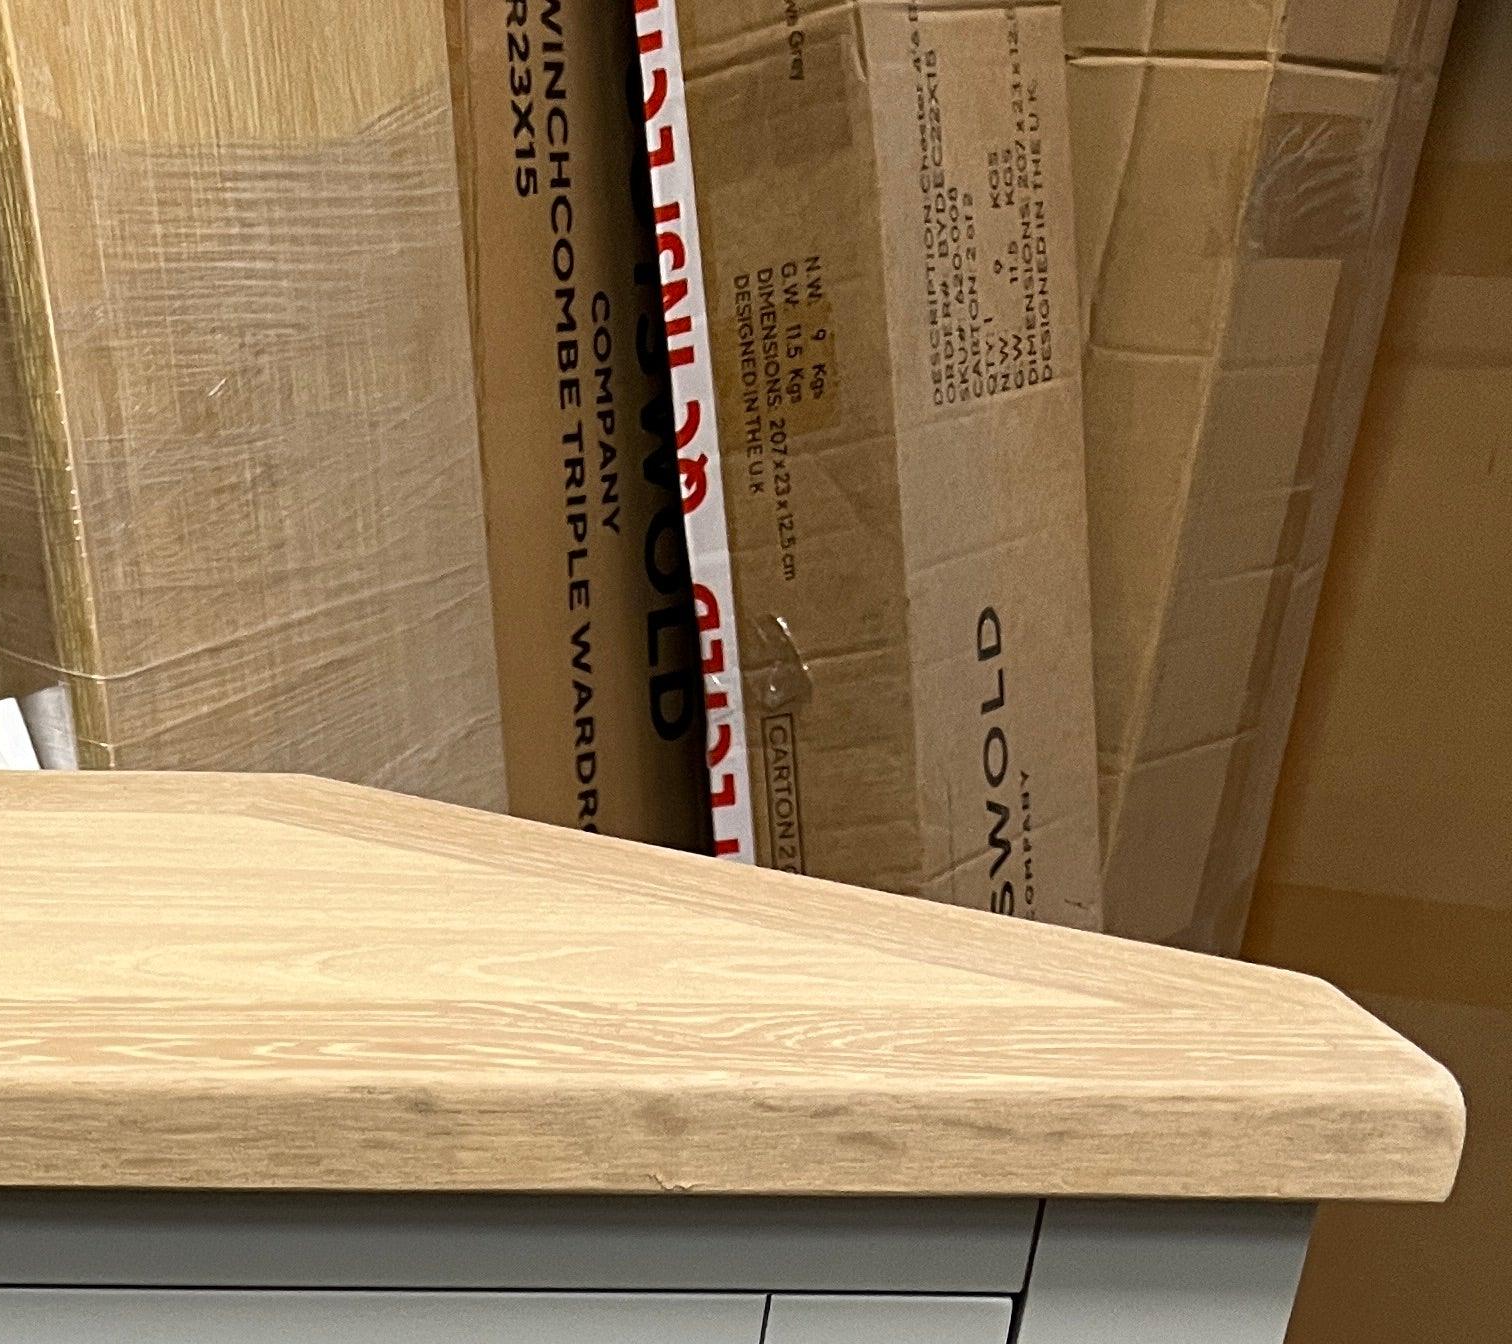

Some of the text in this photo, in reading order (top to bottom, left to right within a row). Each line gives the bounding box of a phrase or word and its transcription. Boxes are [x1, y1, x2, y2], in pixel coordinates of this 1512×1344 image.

[732, 273, 759, 388] DESIGNED
[811, 327, 828, 342] 9
[591, 290, 621, 535] COMPANY
[743, 390, 760, 414] IN
[744, 414, 764, 459] THE
[768, 416, 788, 456] 207
[773, 471, 792, 497] 23
[562, 419, 590, 612] TRIPLE
[781, 552, 797, 582] cm
[768, 724, 796, 841] CARTON
